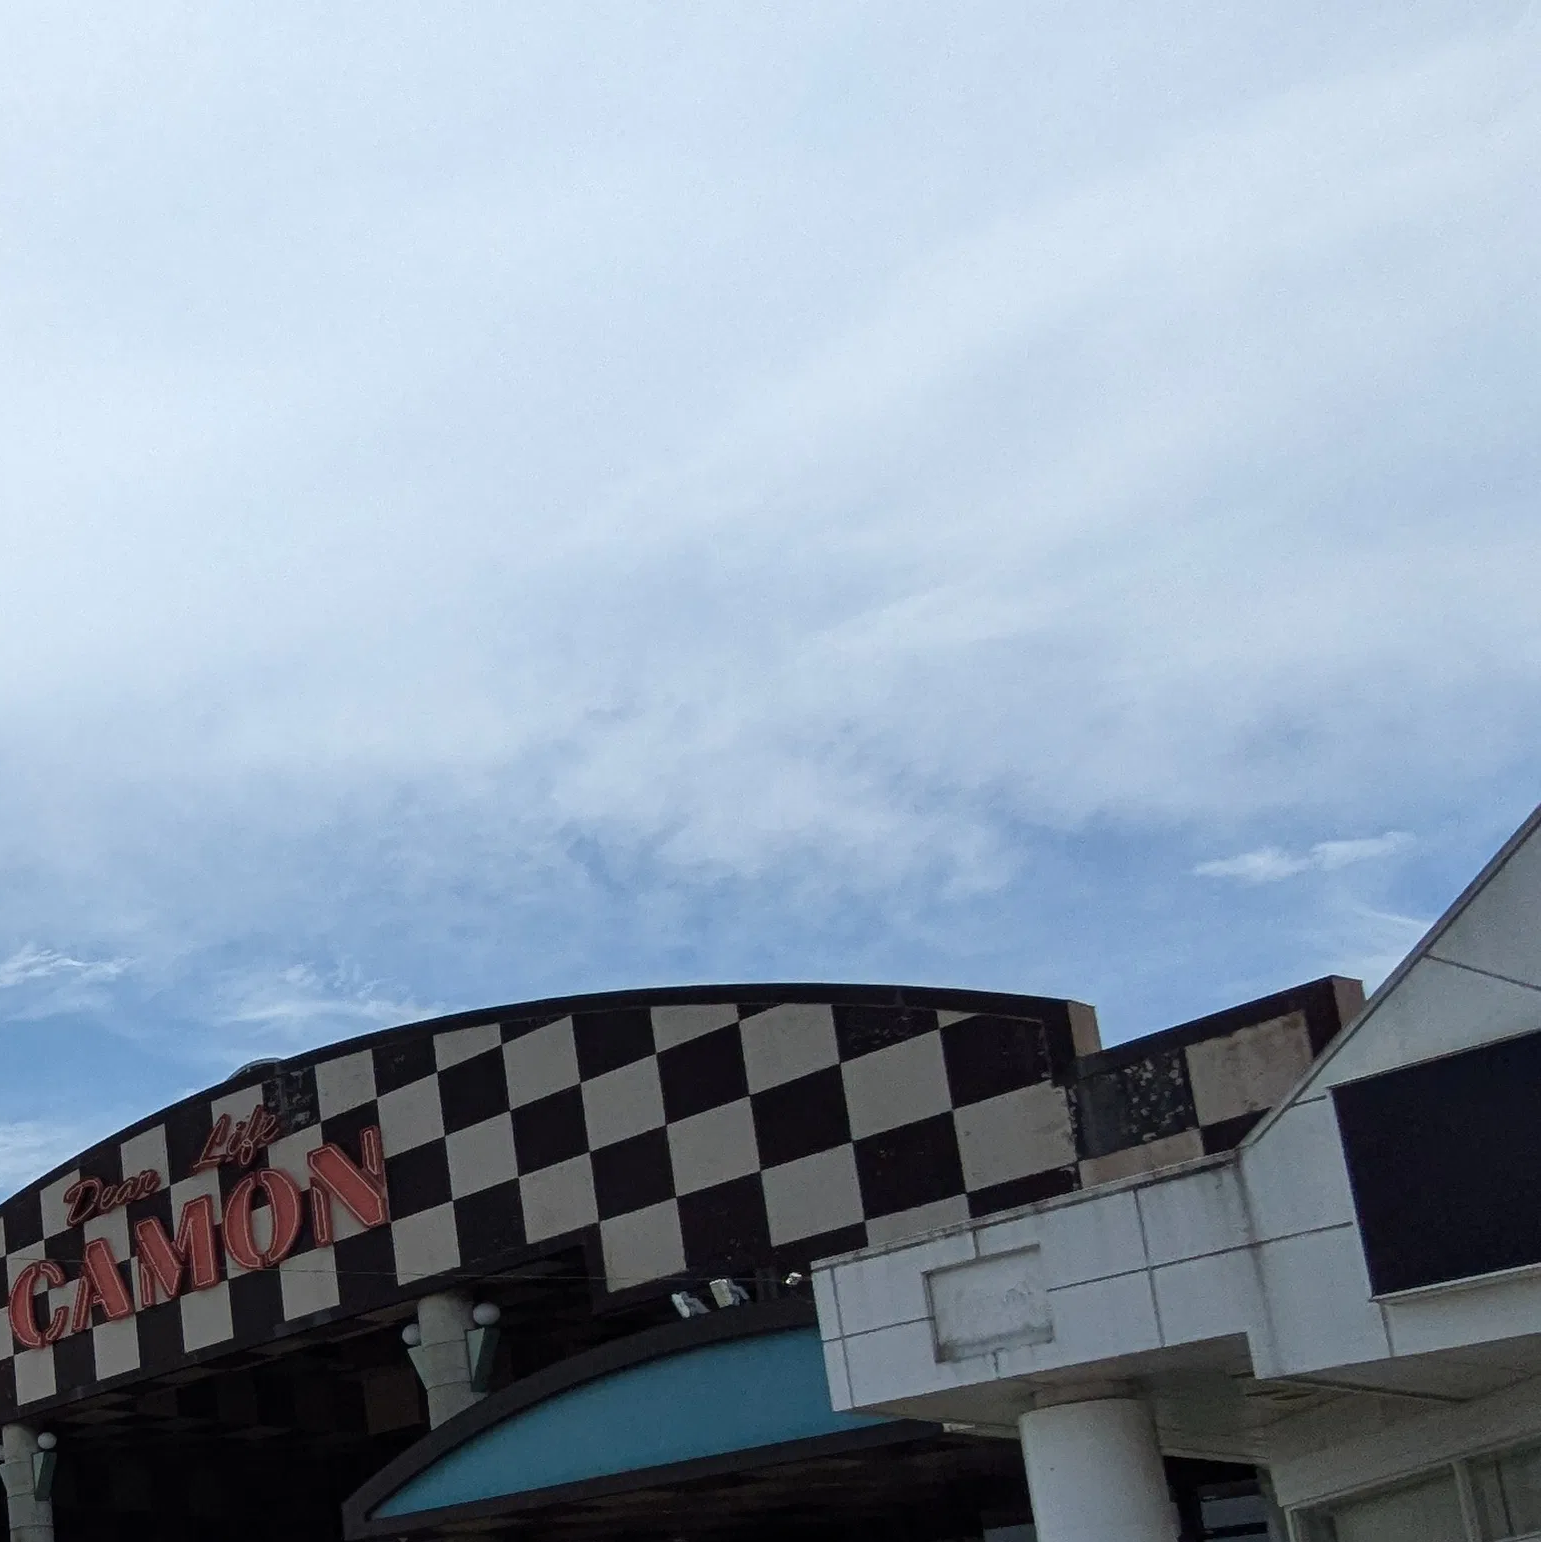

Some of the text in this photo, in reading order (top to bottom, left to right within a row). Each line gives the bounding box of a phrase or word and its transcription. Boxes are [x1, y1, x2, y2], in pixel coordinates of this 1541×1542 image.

[8, 1125, 389, 1349] CAMON
[63, 1103, 281, 1227] Dear Life
